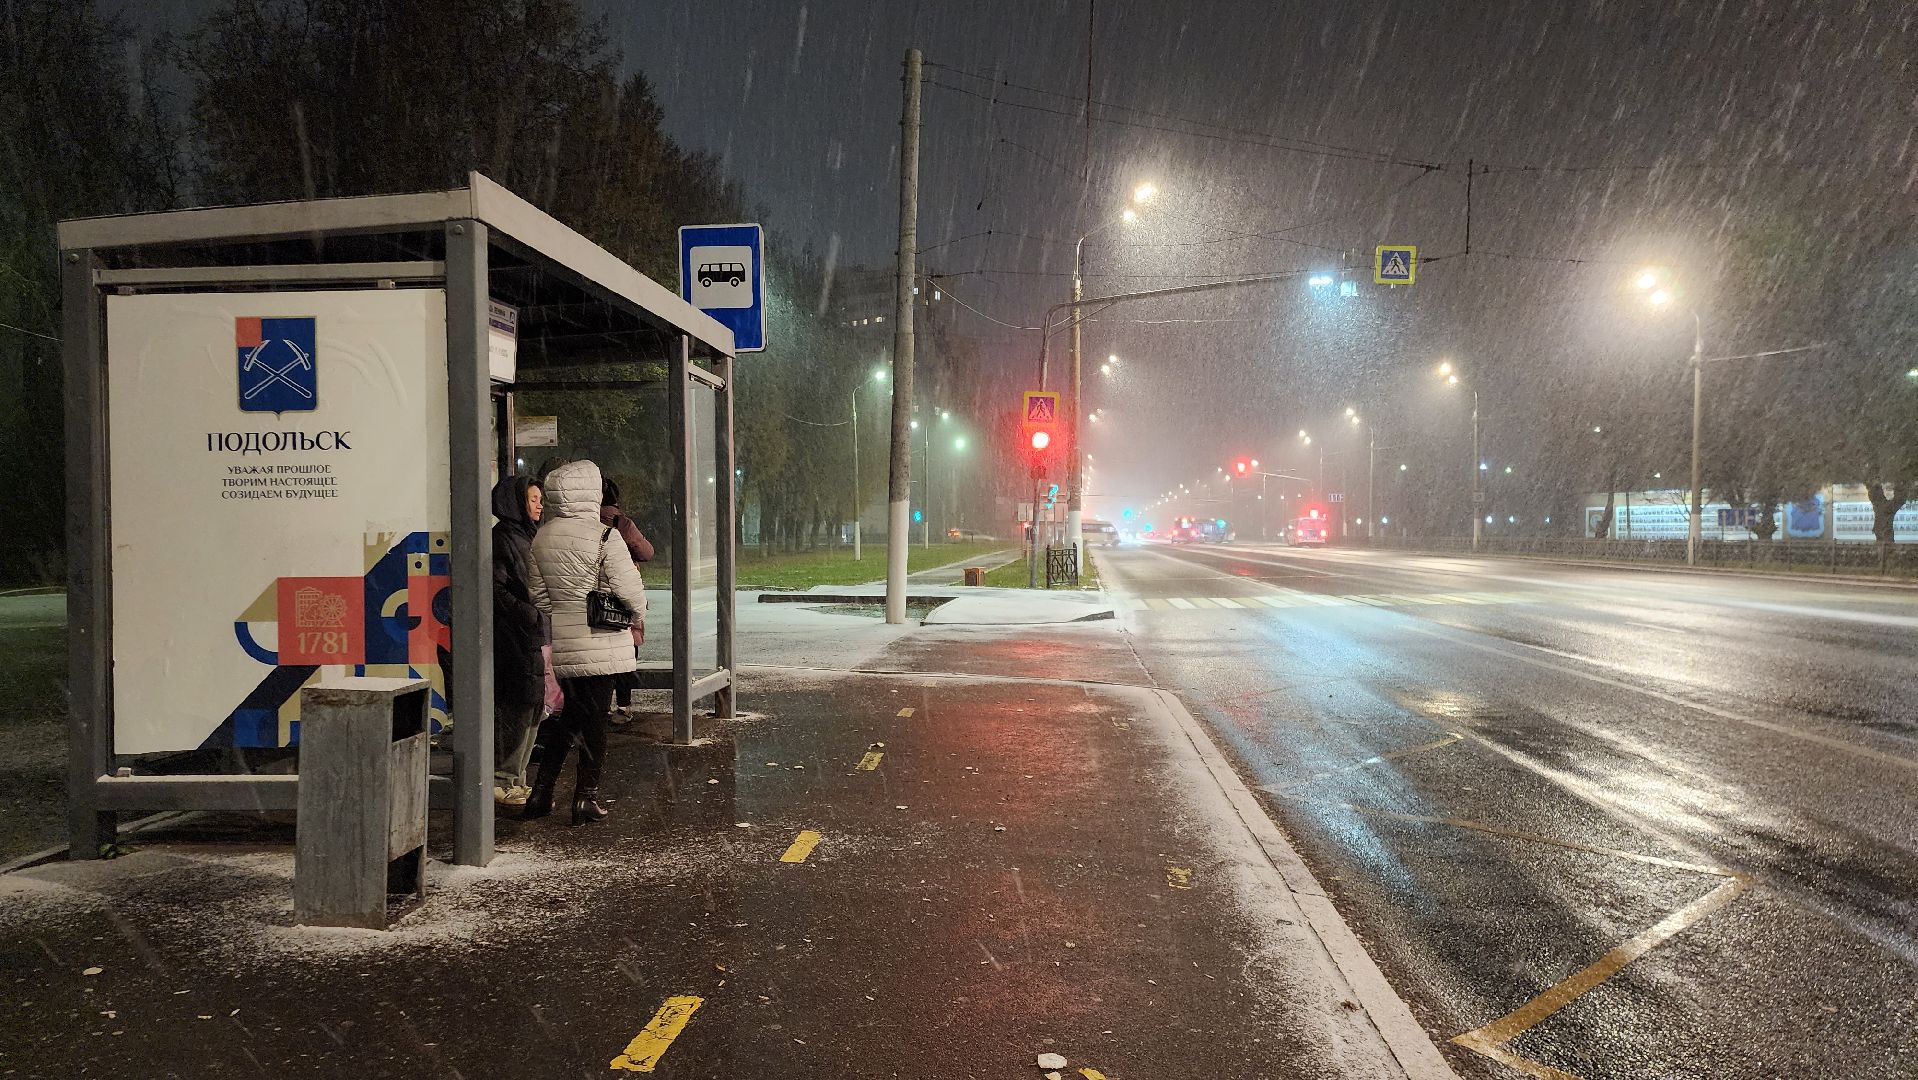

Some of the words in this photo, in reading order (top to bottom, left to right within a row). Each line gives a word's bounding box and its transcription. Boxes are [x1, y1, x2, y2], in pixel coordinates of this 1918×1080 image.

[207, 431, 352, 455] ПОДОЛЬСК
[227, 465, 273, 474] УВАЖАЯ
[277, 465, 331, 474] ПРОШЛОЕ
[222, 478, 267, 487] ТВОРИМ
[270, 477, 338, 487] НАСТОЯЩЕЕ
[222, 490, 282, 500] СОЗИДАЕМ
[285, 489, 338, 499] БУДУЩЕЕ
[298, 632, 348, 654] 1781
